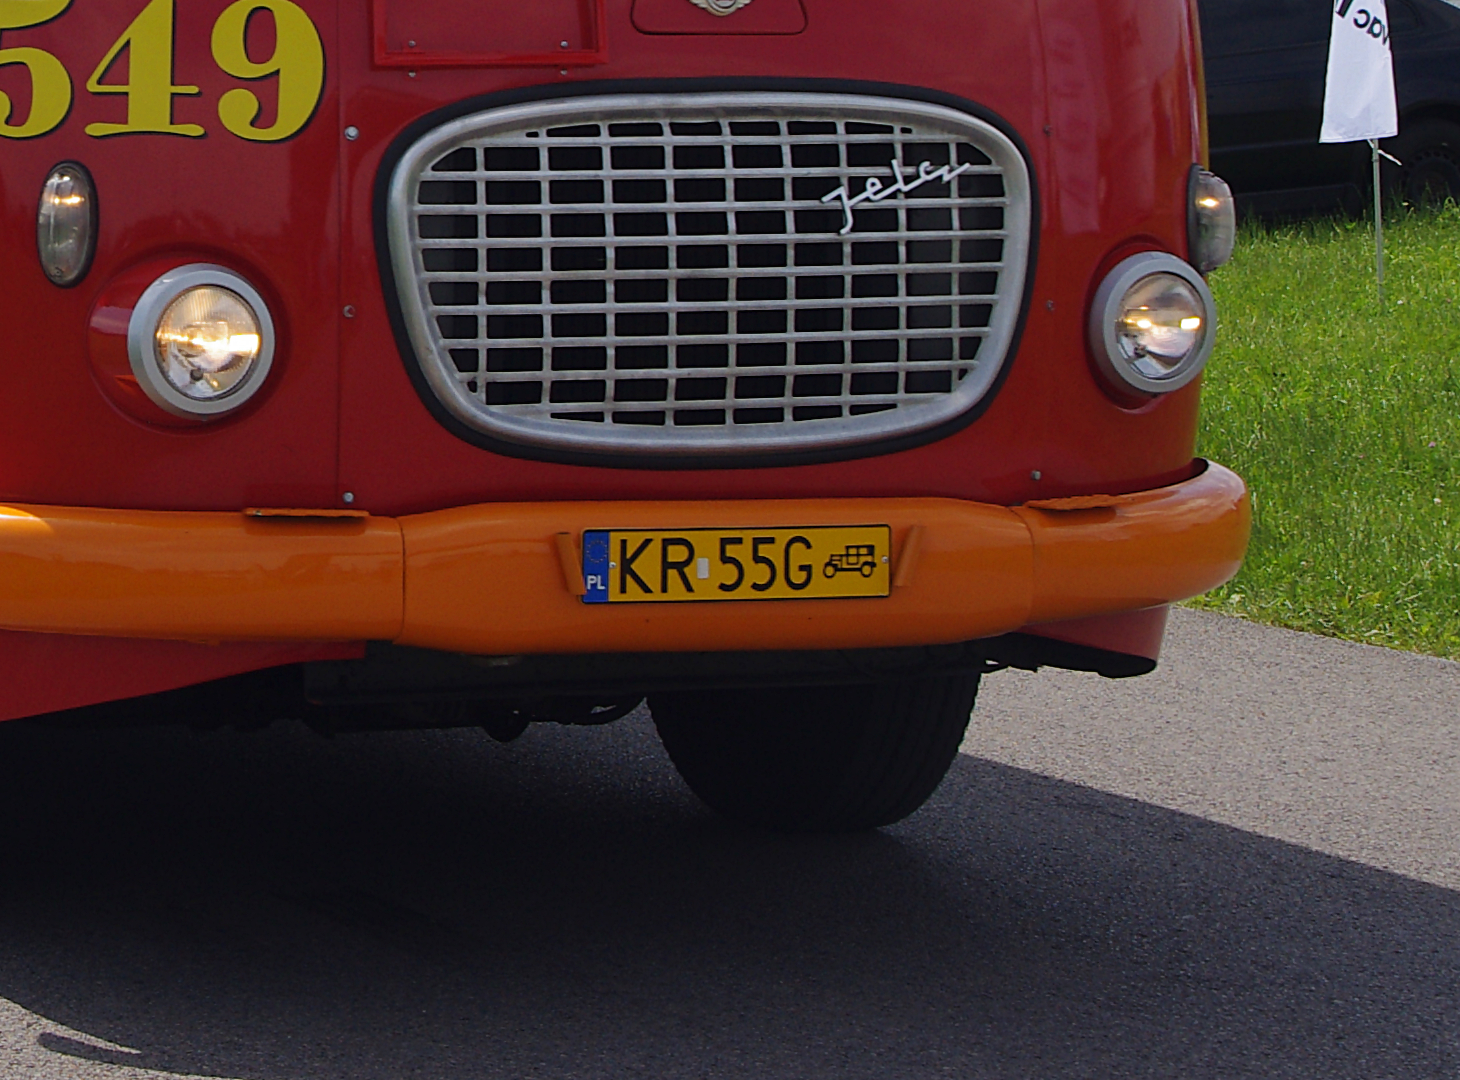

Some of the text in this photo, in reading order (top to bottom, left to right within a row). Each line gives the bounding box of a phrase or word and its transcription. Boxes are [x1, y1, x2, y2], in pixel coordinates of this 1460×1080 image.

[586, 575, 605, 591] PL
[619, 535, 813, 594] KR 55G
